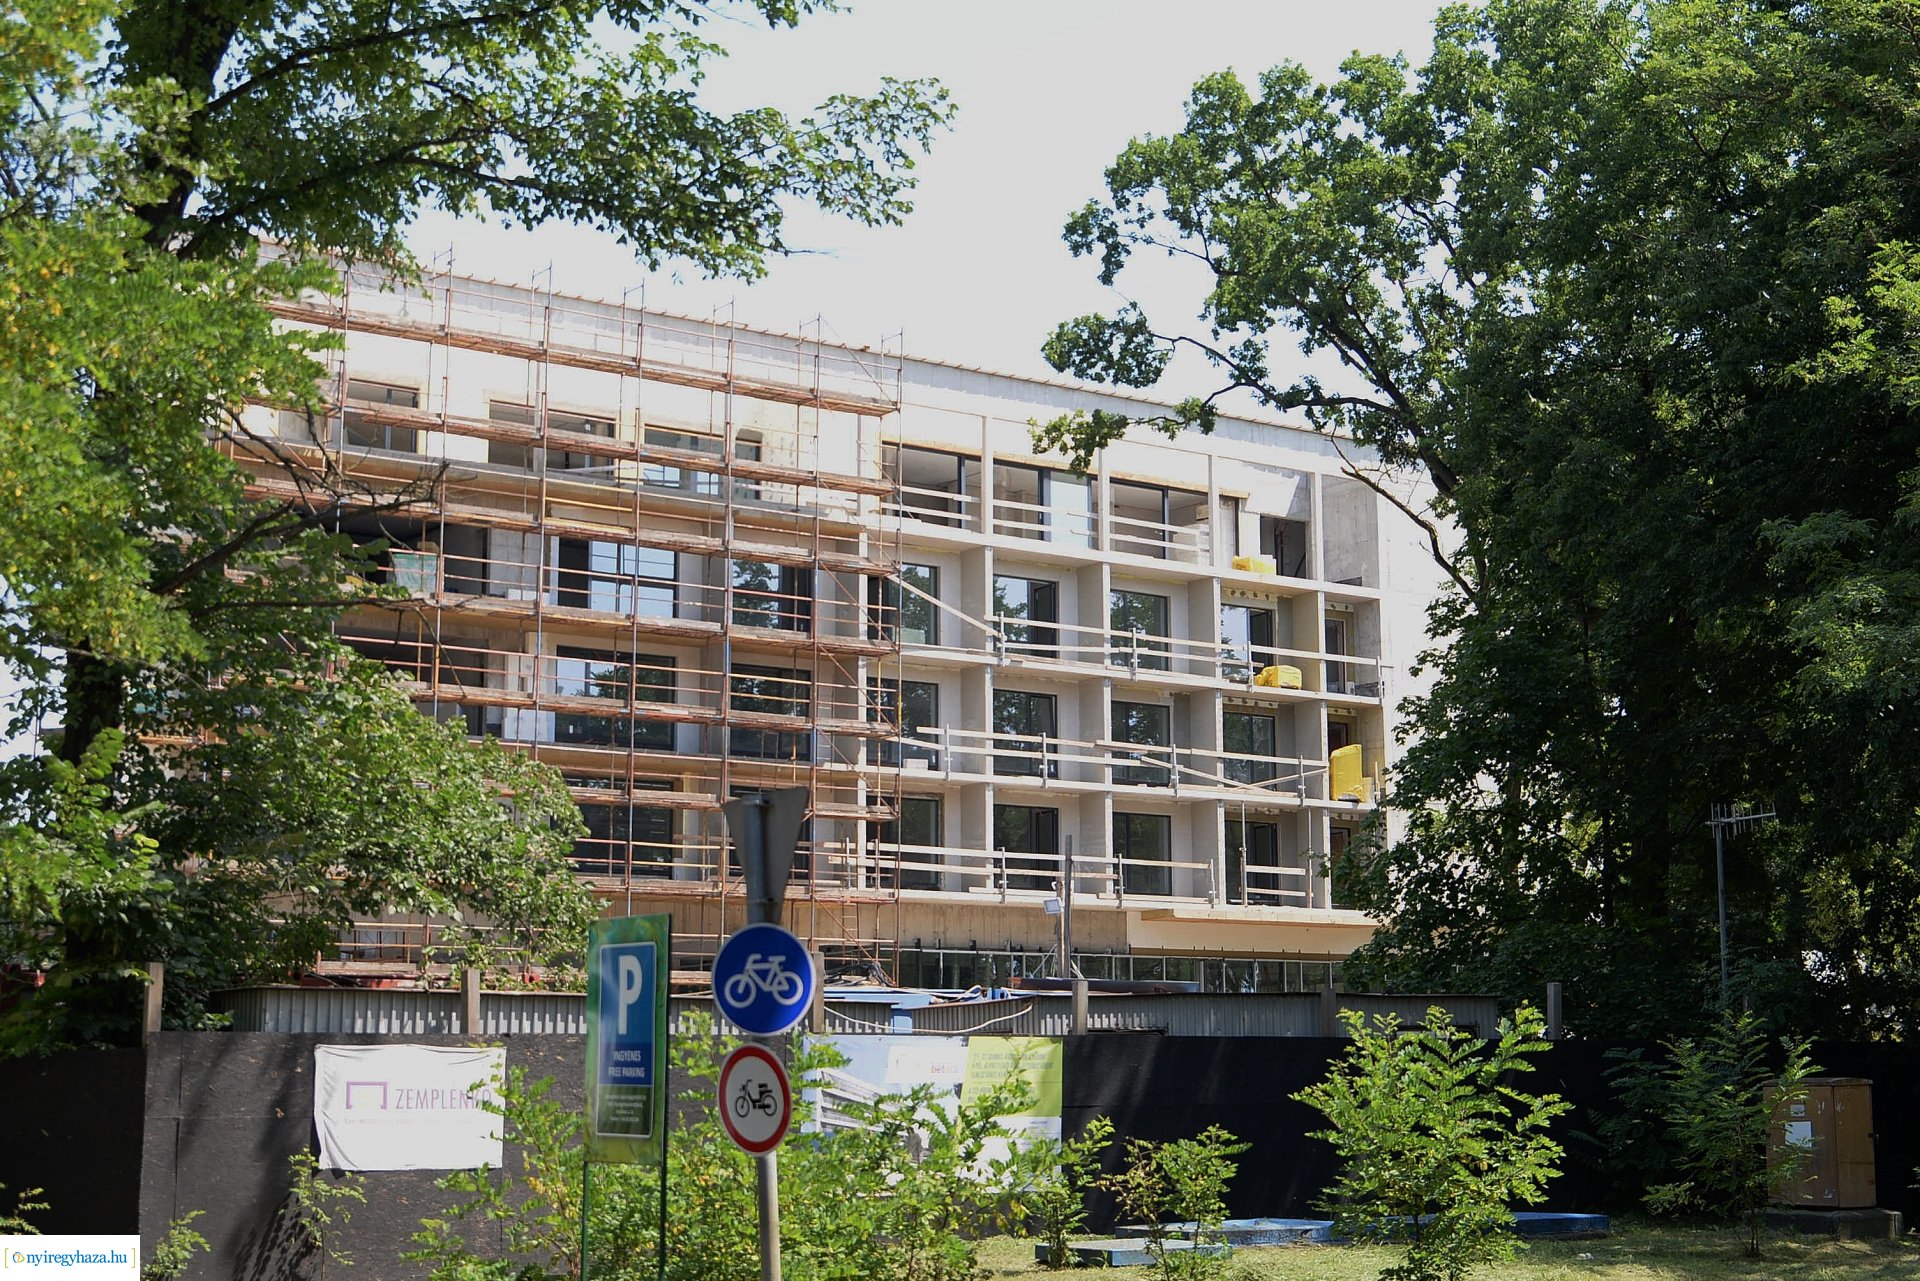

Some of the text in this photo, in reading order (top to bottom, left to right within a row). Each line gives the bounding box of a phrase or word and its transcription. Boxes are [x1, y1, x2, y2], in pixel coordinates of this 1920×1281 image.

[618, 955, 643, 1035] P
[613, 1050, 642, 1062] INGYENES
[608, 1066, 646, 1078] FREE PARKING
